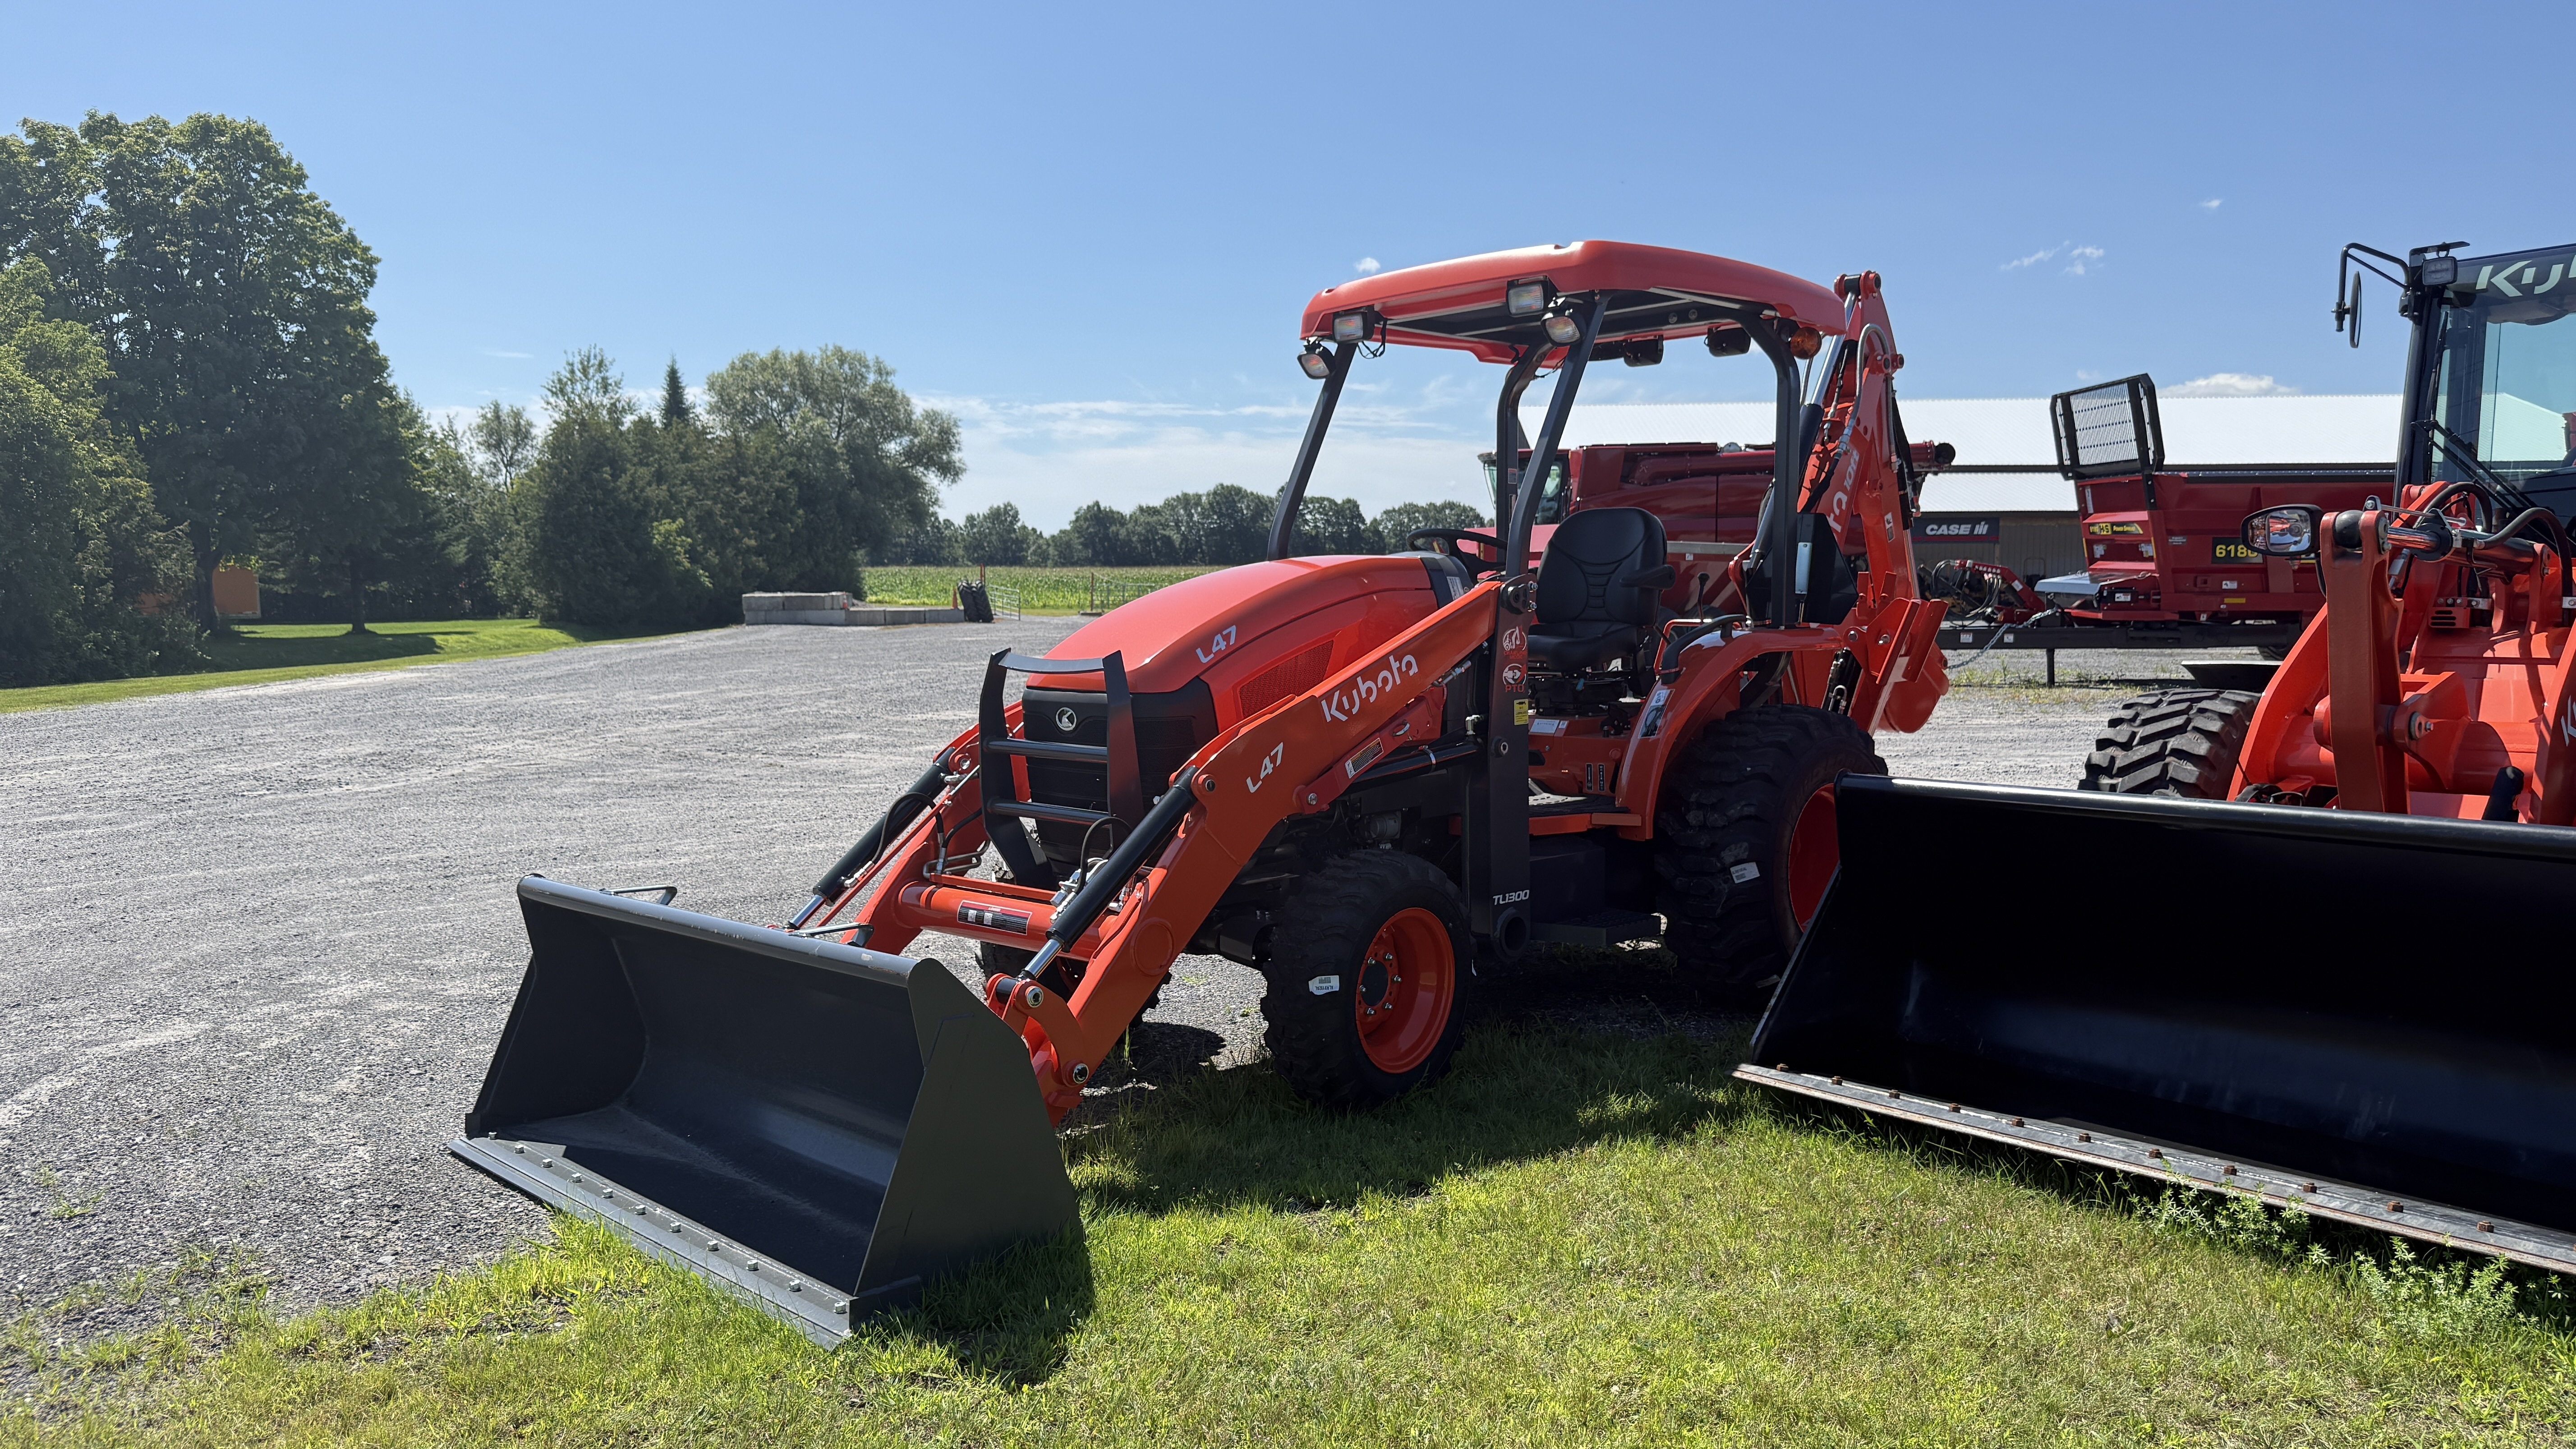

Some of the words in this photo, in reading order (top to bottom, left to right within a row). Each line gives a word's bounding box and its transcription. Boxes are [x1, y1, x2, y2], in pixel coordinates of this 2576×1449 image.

[2476, 255, 2576, 297] Ku
[1926, 524, 1971, 535] CASE
[1196, 625, 1236, 663] L47
[1321, 654, 1418, 722] Kubota
[1505, 684, 1525, 693] PTO
[1246, 741, 1283, 793] L47
[1492, 889, 1530, 906] TL1300
